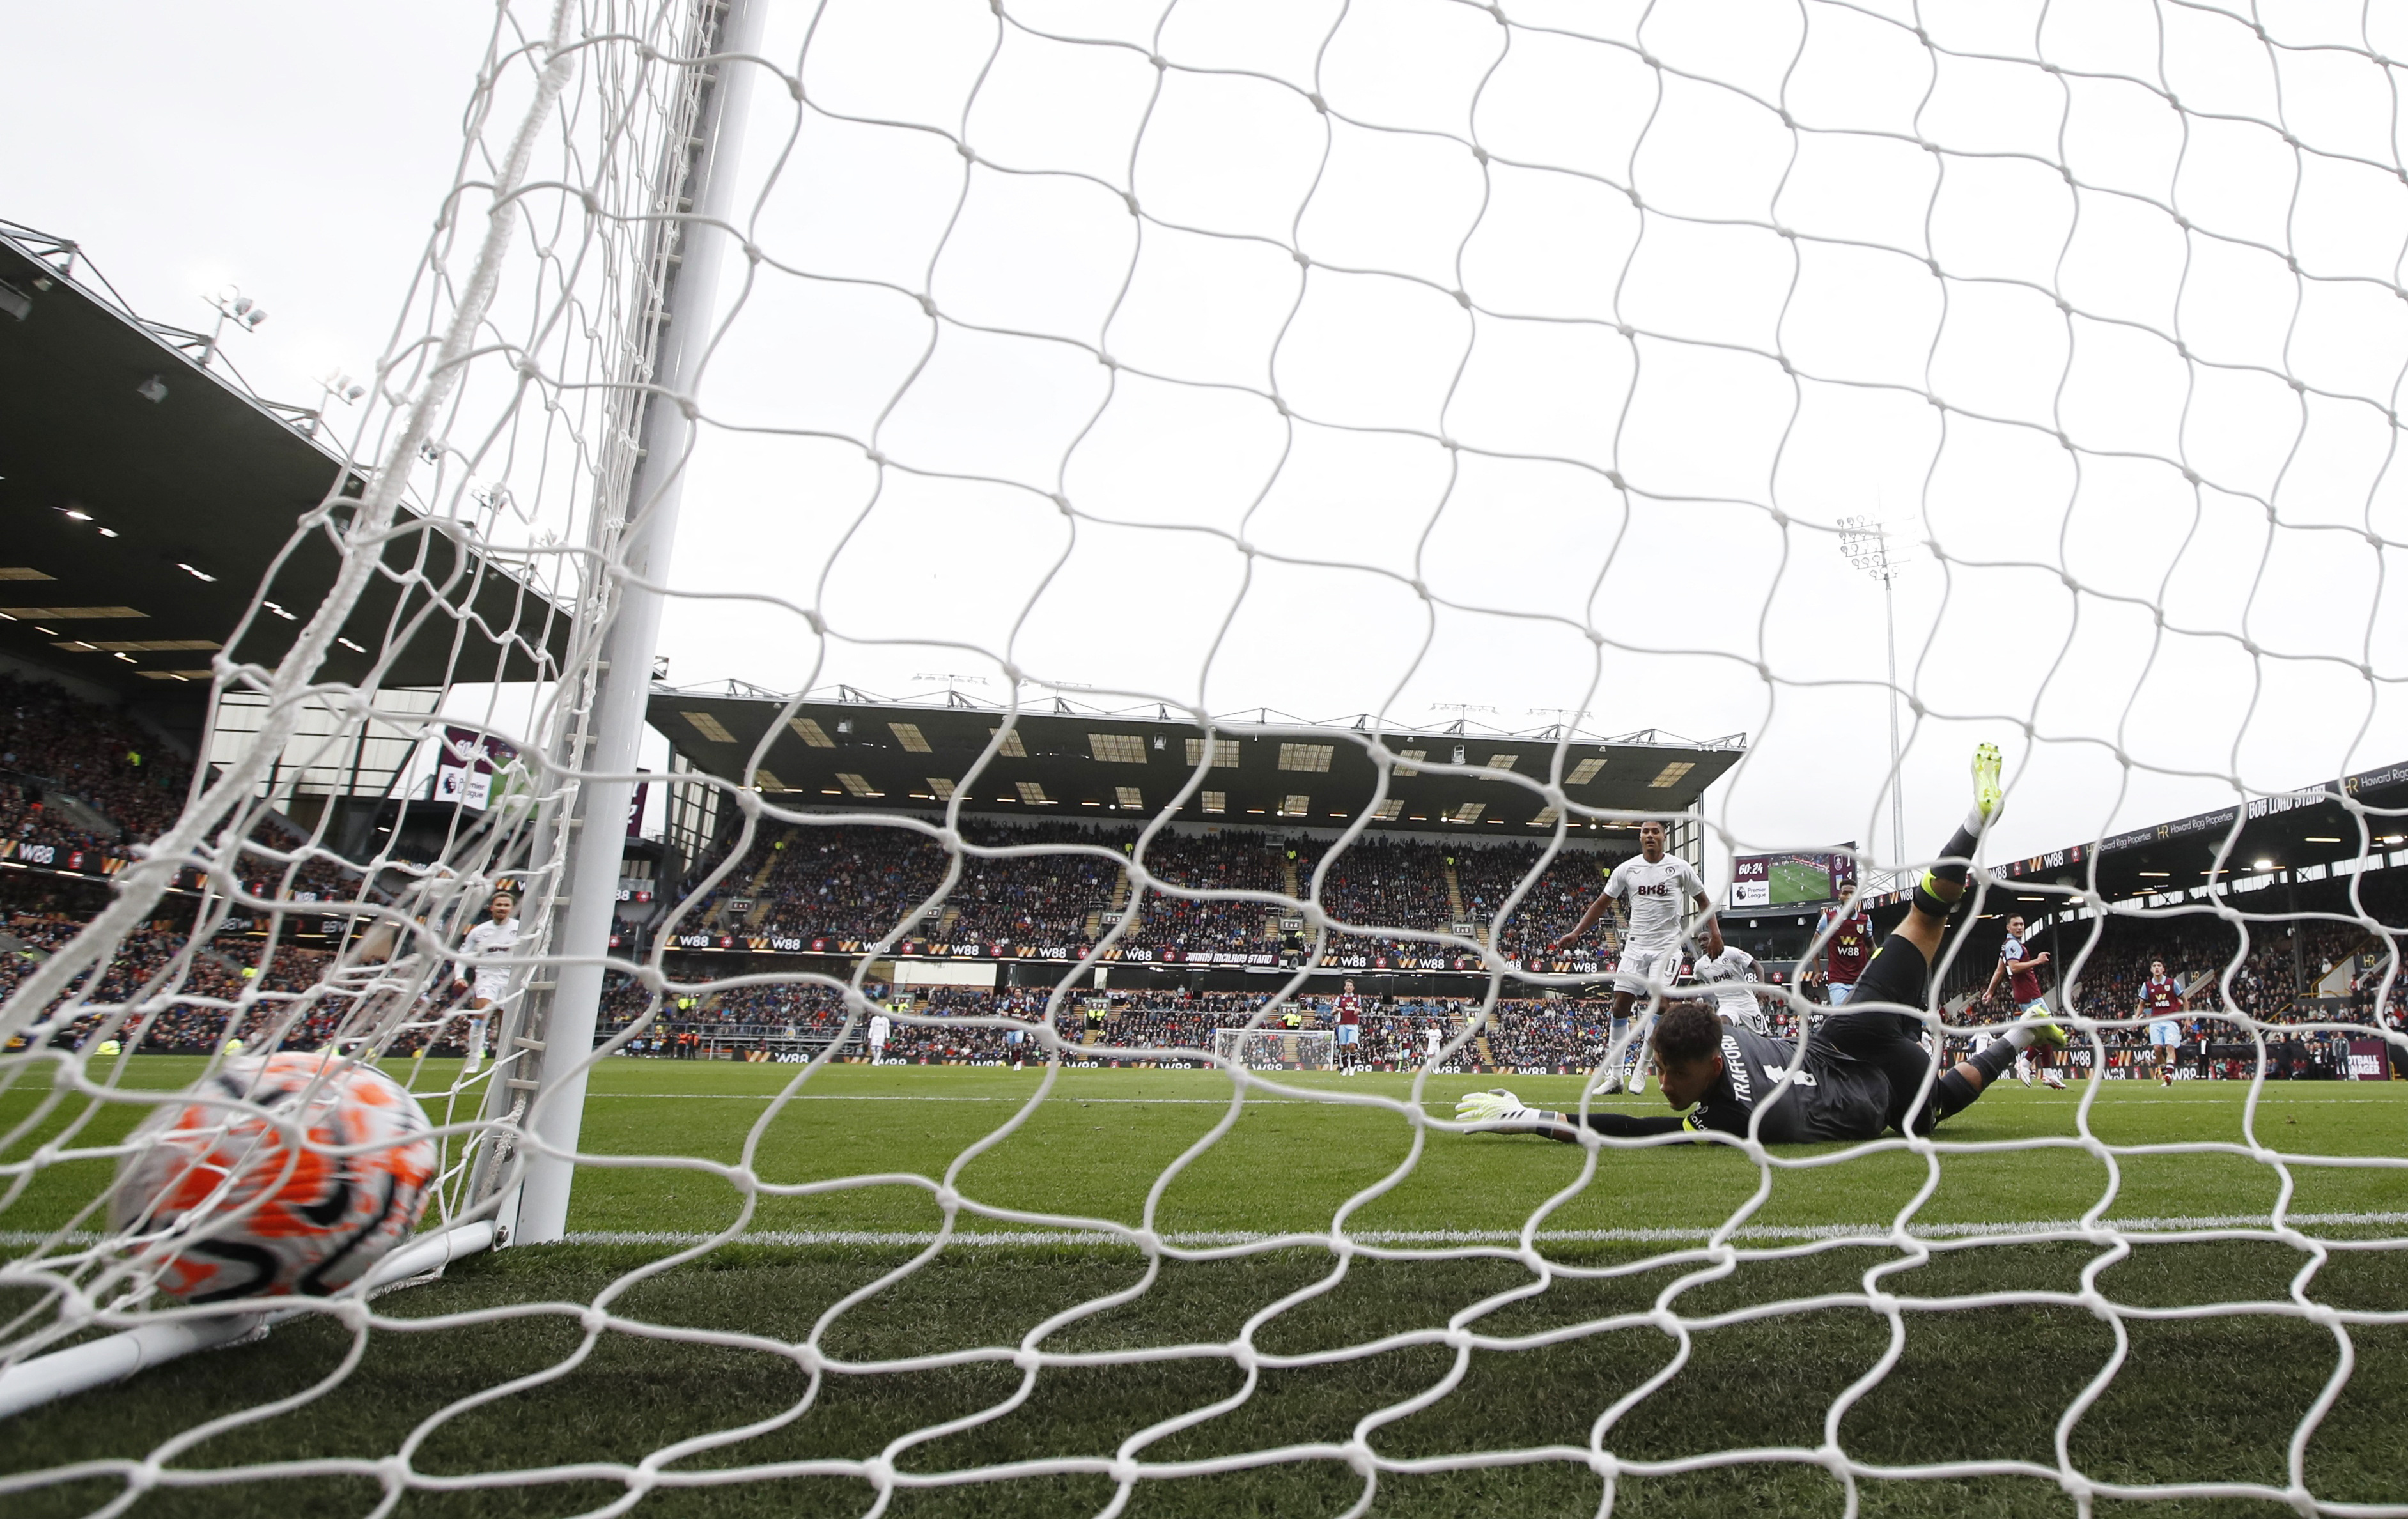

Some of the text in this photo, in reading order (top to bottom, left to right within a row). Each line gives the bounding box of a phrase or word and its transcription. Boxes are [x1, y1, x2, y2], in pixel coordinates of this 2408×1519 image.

[2361, 771, 2391, 788] Howard
[2248, 801, 2267, 820] BOB
[2157, 812, 2234, 840] HR Howard Rigg Properties
[2115, 837, 2127, 849] Rigg
[2127, 831, 2152, 845] Properties
[19, 843, 55, 864] W88
[2044, 851, 2065, 868] W88
[1738, 862, 1764, 875] 60:24
[1989, 865, 2007, 880] W88
[1638, 884, 1666, 895] BK8
[1748, 886, 1766, 895] Premier
[1748, 891, 1766, 900] League
[1900, 888, 1914, 902] W88
[616, 890, 631, 902] 88
[1861, 897, 1875, 910] W88
[680, 935, 709, 947] W88
[772, 938, 800, 950] W88
[952, 945, 979, 955] W88
[1039, 948, 1067, 959] W88
[1126, 950, 1153, 961] W88
[1837, 946, 1860, 956] W88
[1185, 952, 1213, 962] JIMMY
[1248, 954, 1273, 964] STAND
[1340, 957, 1367, 967] W88
[1419, 959, 1445, 969] W88
[2363, 954, 2375, 968] HR
[1573, 962, 1597, 973] W88
[1713, 971, 1732, 983] BK8
[1752, 1014, 1762, 1026] 19
[775, 1052, 809, 1063] W88
[2069, 1050, 2091, 1067] W88
[1353, 1064, 1373, 1072] 88
[1518, 1067, 1547, 1075] W88
[1721, 1035, 1752, 1102] TRAFFORD
